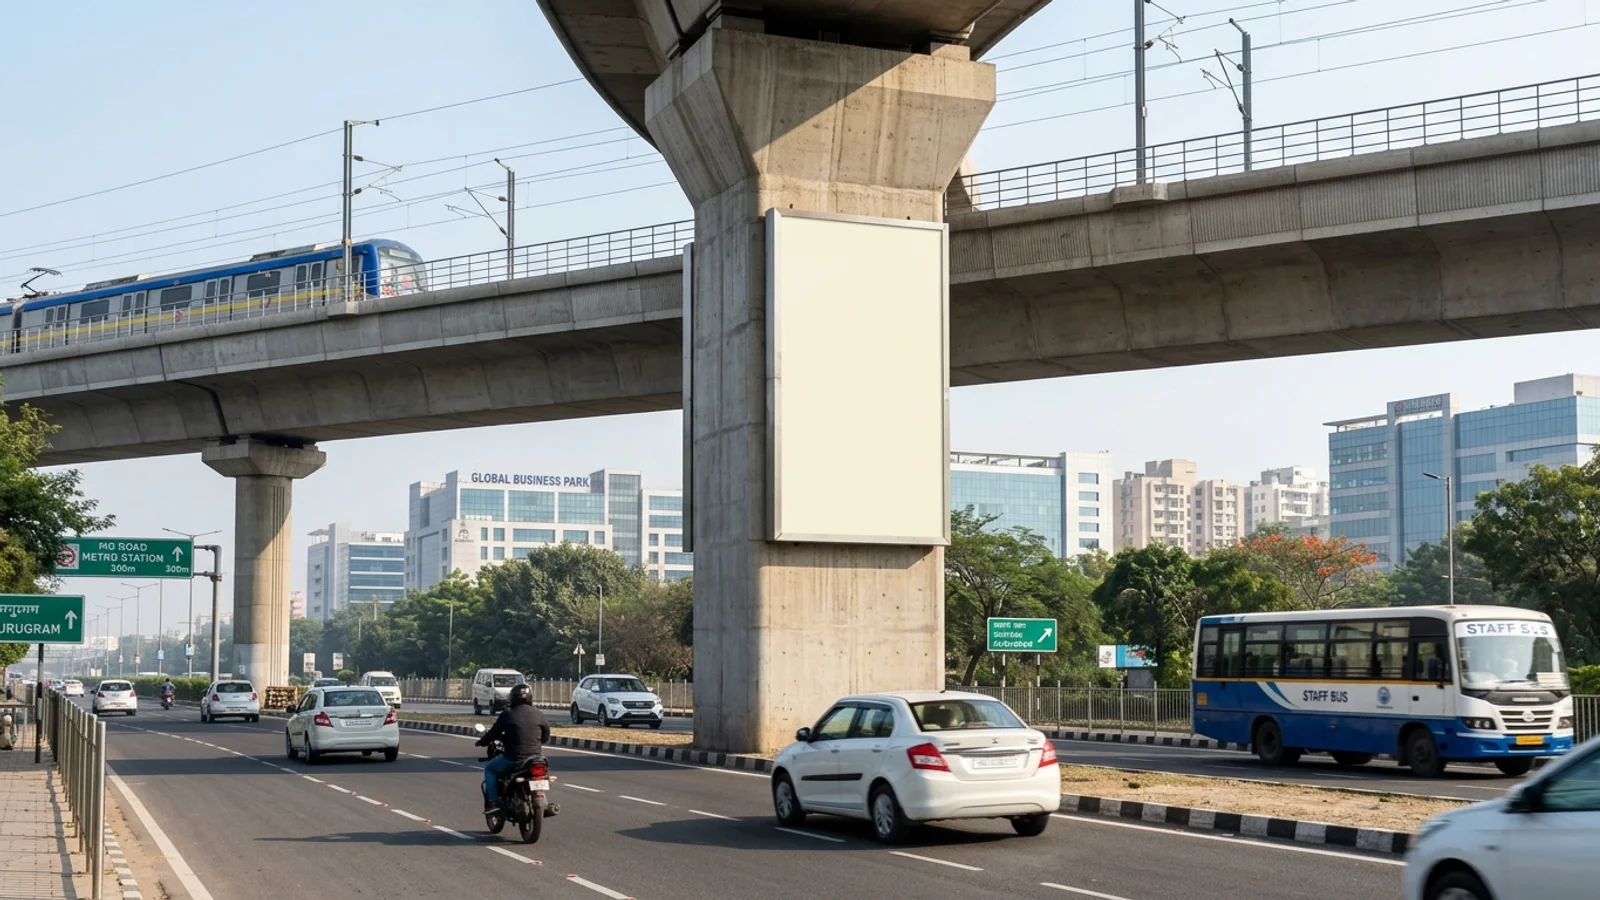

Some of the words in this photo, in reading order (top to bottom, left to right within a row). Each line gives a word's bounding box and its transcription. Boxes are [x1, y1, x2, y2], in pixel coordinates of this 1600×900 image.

[471, 472, 511, 484] GLOBAL
[513, 474, 561, 486] BUSINESS
[563, 476, 590, 488] PARK
[121, 553, 164, 563] STATION
[111, 564, 136, 573] 300m
[165, 565, 189, 574] 300m
[0, 623, 61, 635] URUGRAM
[1466, 623, 1515, 635] STAFF
[1303, 690, 1329, 702] STAFF
